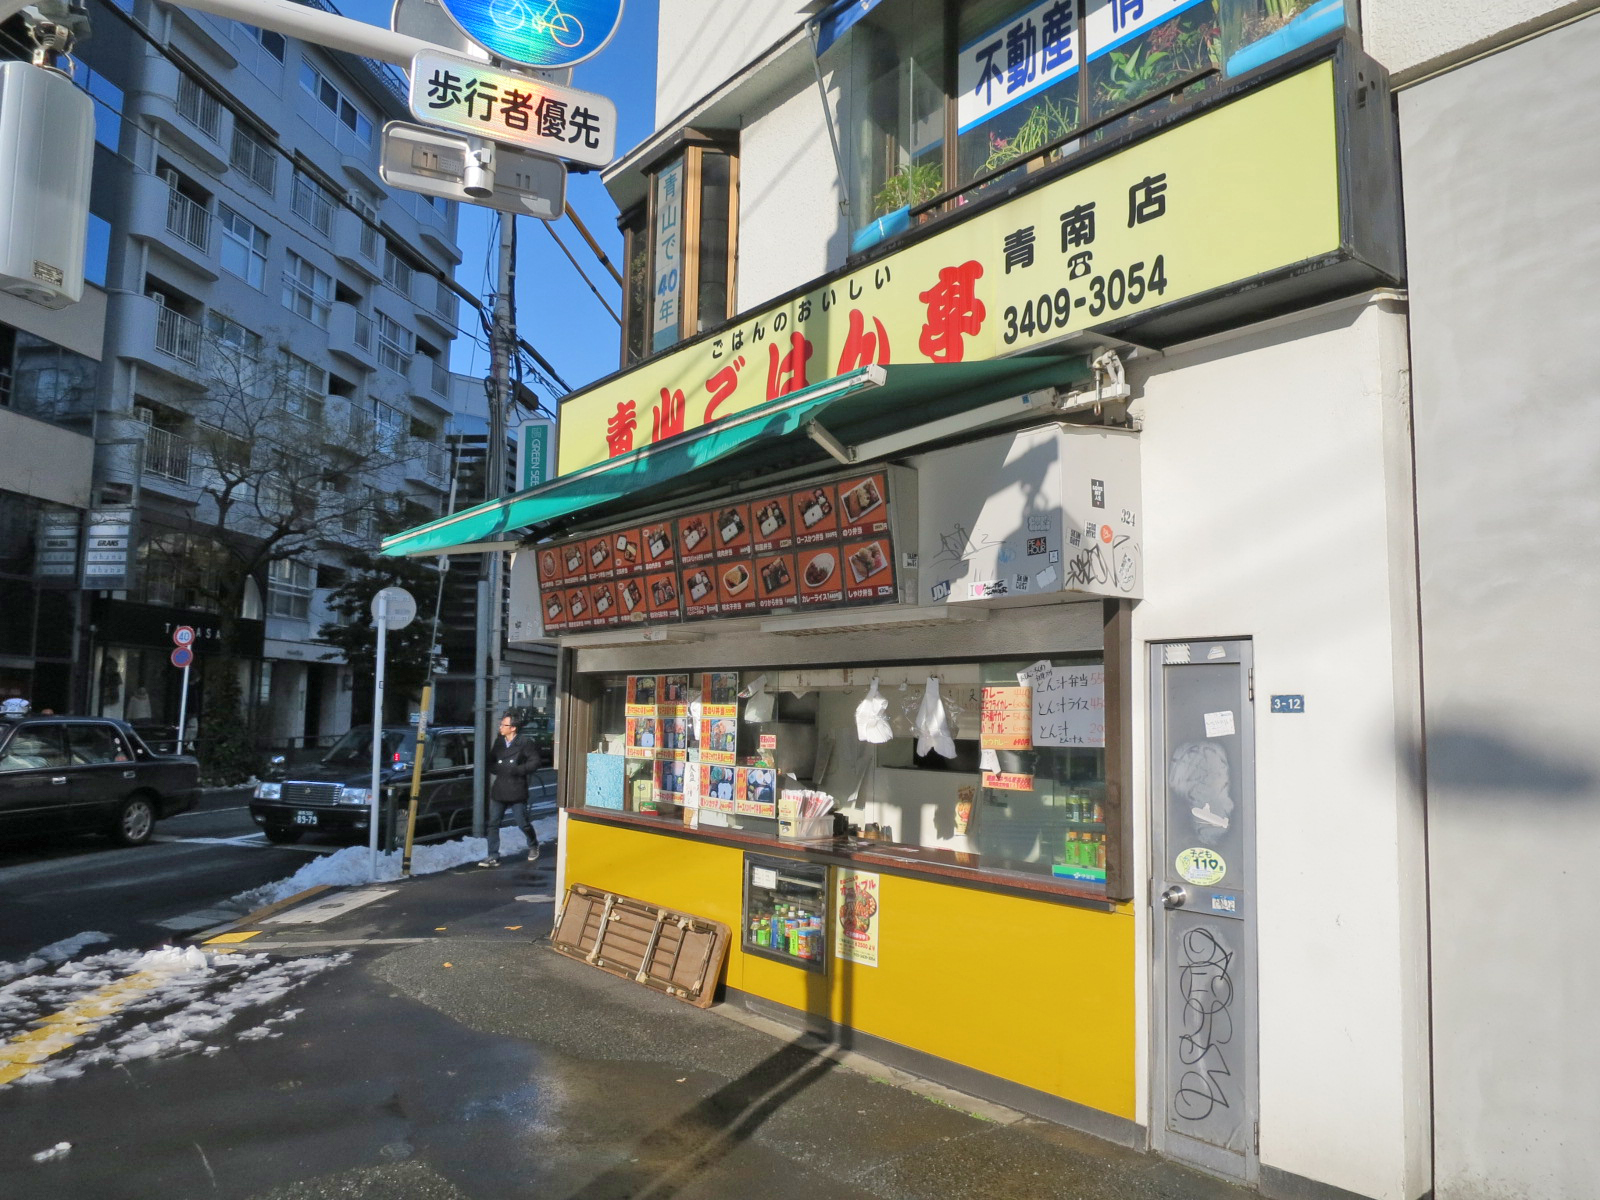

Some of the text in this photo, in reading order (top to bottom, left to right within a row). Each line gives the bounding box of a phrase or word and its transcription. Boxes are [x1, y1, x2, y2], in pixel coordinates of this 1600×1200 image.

[974, 0, 1074, 107] 不動産
[427, 68, 603, 151] 歩行者優先
[1003, 172, 1168, 276] 青南店
[657, 172, 679, 325] 青山で40年
[1003, 254, 1168, 345] 3409-3054
[711, 265, 892, 360] ごはんのおいしい
[530, 438, 541, 469] GREEN
[1120, 508, 1137, 528] 324
[842, 526, 863, 538] のり弁当
[1027, 545, 1046, 556] HOUR
[801, 592, 828, 604] カレーライス
[847, 587, 873, 599] しゃけ弁当
[165, 622, 222, 640] TASA
[178, 631, 190, 641] 40
[1036, 671, 1104, 694] とん汁弁当 55
[981, 687, 1005, 699] カレー
[1038, 696, 1104, 716] とん汁ライス 45
[1273, 697, 1302, 710] 3-12
[1039, 720, 1069, 739] とん汁
[296, 815, 319, 825] 89-79
[1189, 848, 1213, 859] 子ども
[1192, 857, 1219, 871] 110
